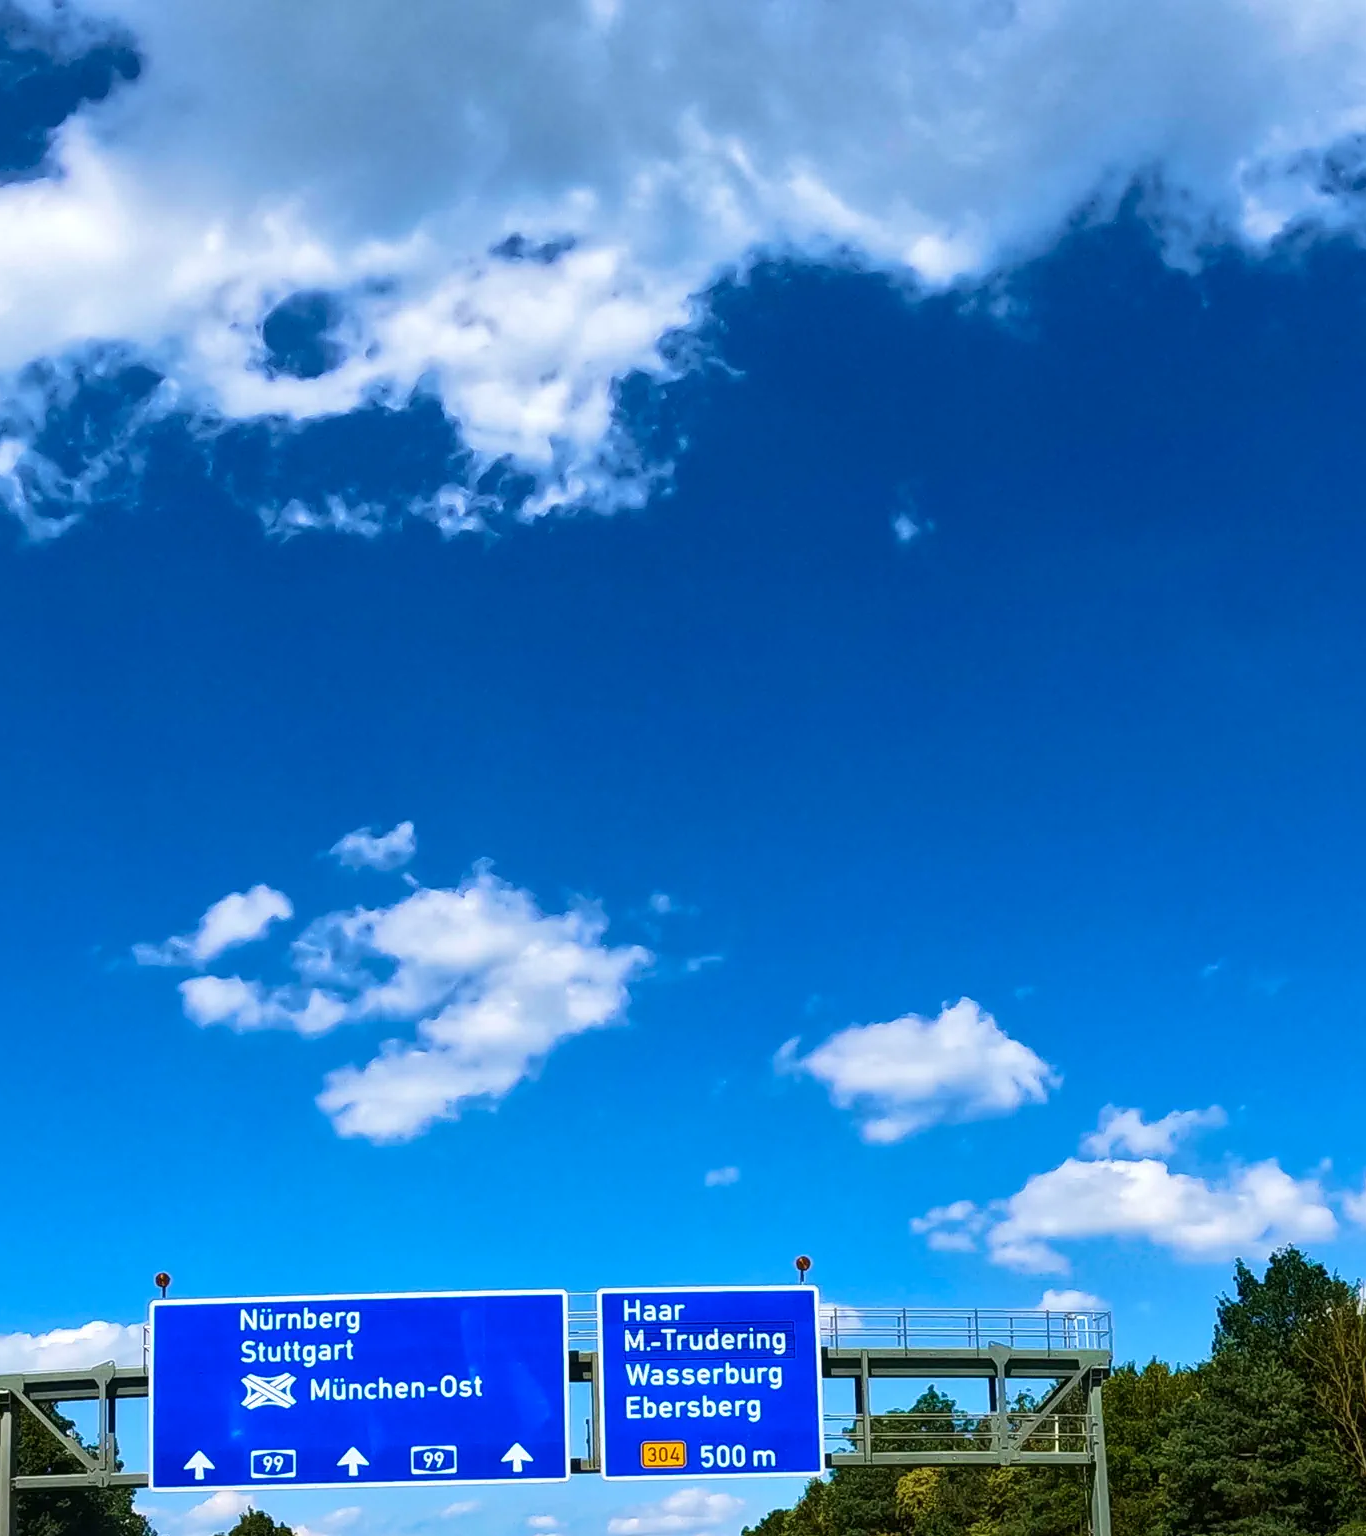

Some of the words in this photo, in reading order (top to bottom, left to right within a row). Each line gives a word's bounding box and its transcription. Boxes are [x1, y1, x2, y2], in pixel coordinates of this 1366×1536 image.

[241, 1308, 359, 1333] Nürnberg
[624, 1300, 684, 1321] Haar
[241, 1340, 353, 1367] Stuttgart
[625, 1328, 785, 1354] M.-Trudering
[311, 1375, 482, 1400] München-Ost
[626, 1363, 782, 1389] Wasserburg
[627, 1396, 760, 1422] Ebersberg
[263, 1456, 284, 1472] 99
[424, 1452, 444, 1468] 99
[648, 1447, 679, 1462] 304
[701, 1445, 745, 1467] 500
[753, 1450, 775, 1466] m
